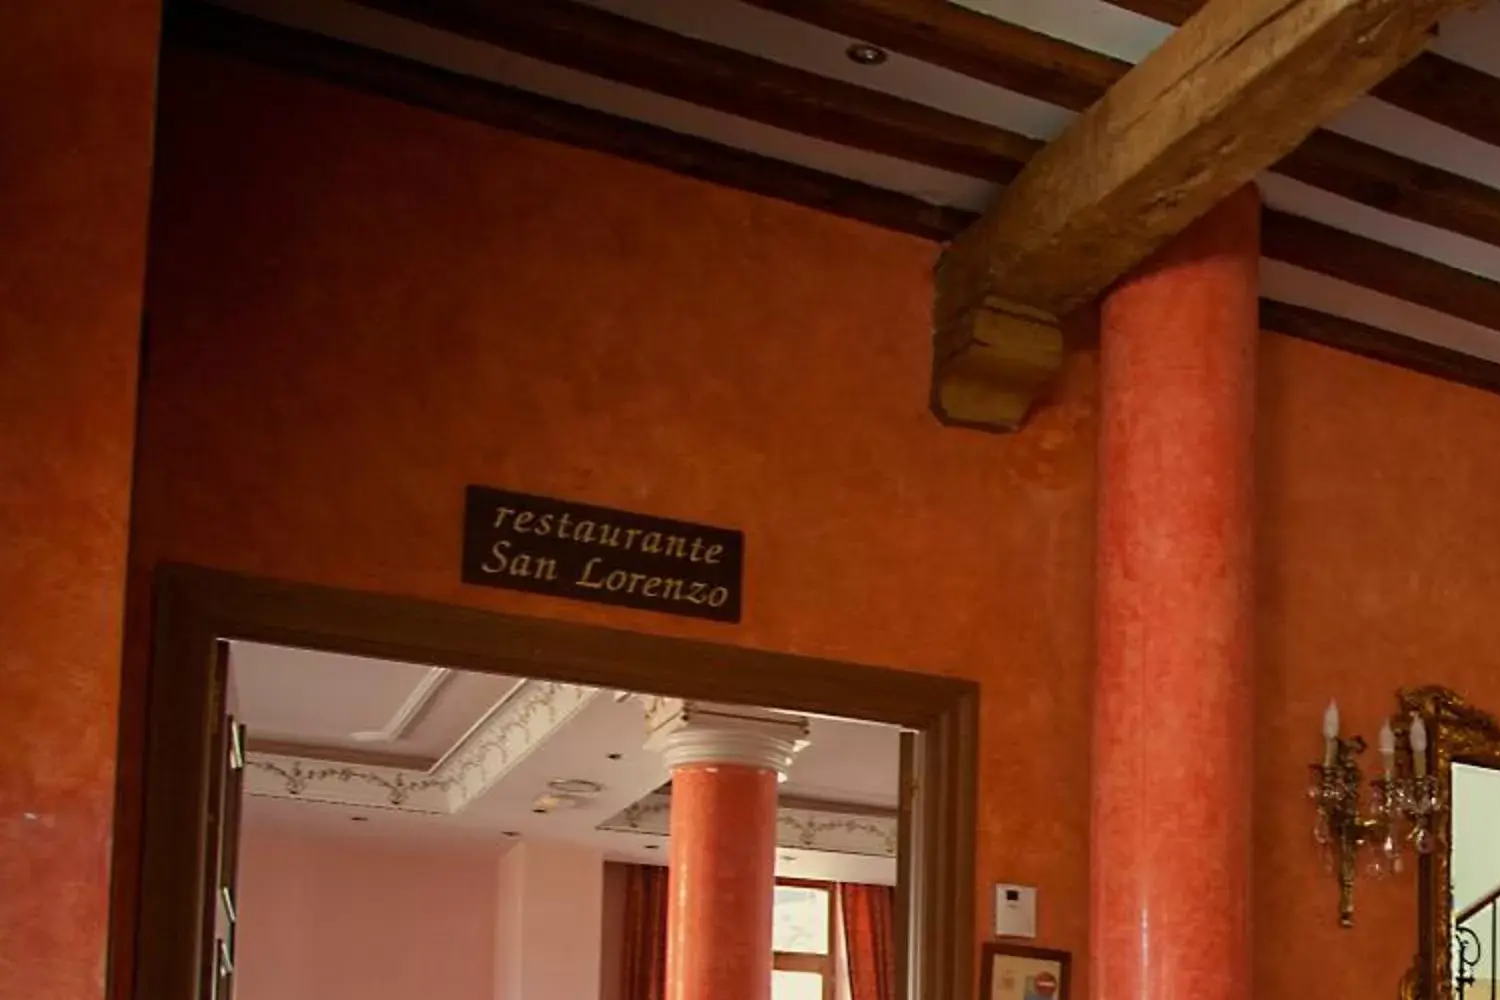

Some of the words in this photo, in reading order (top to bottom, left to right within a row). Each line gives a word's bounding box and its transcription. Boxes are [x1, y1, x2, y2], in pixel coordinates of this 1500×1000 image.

[494, 506, 723, 563] restaurante
[481, 540, 557, 580] San
[576, 557, 729, 607] Lorenzo
